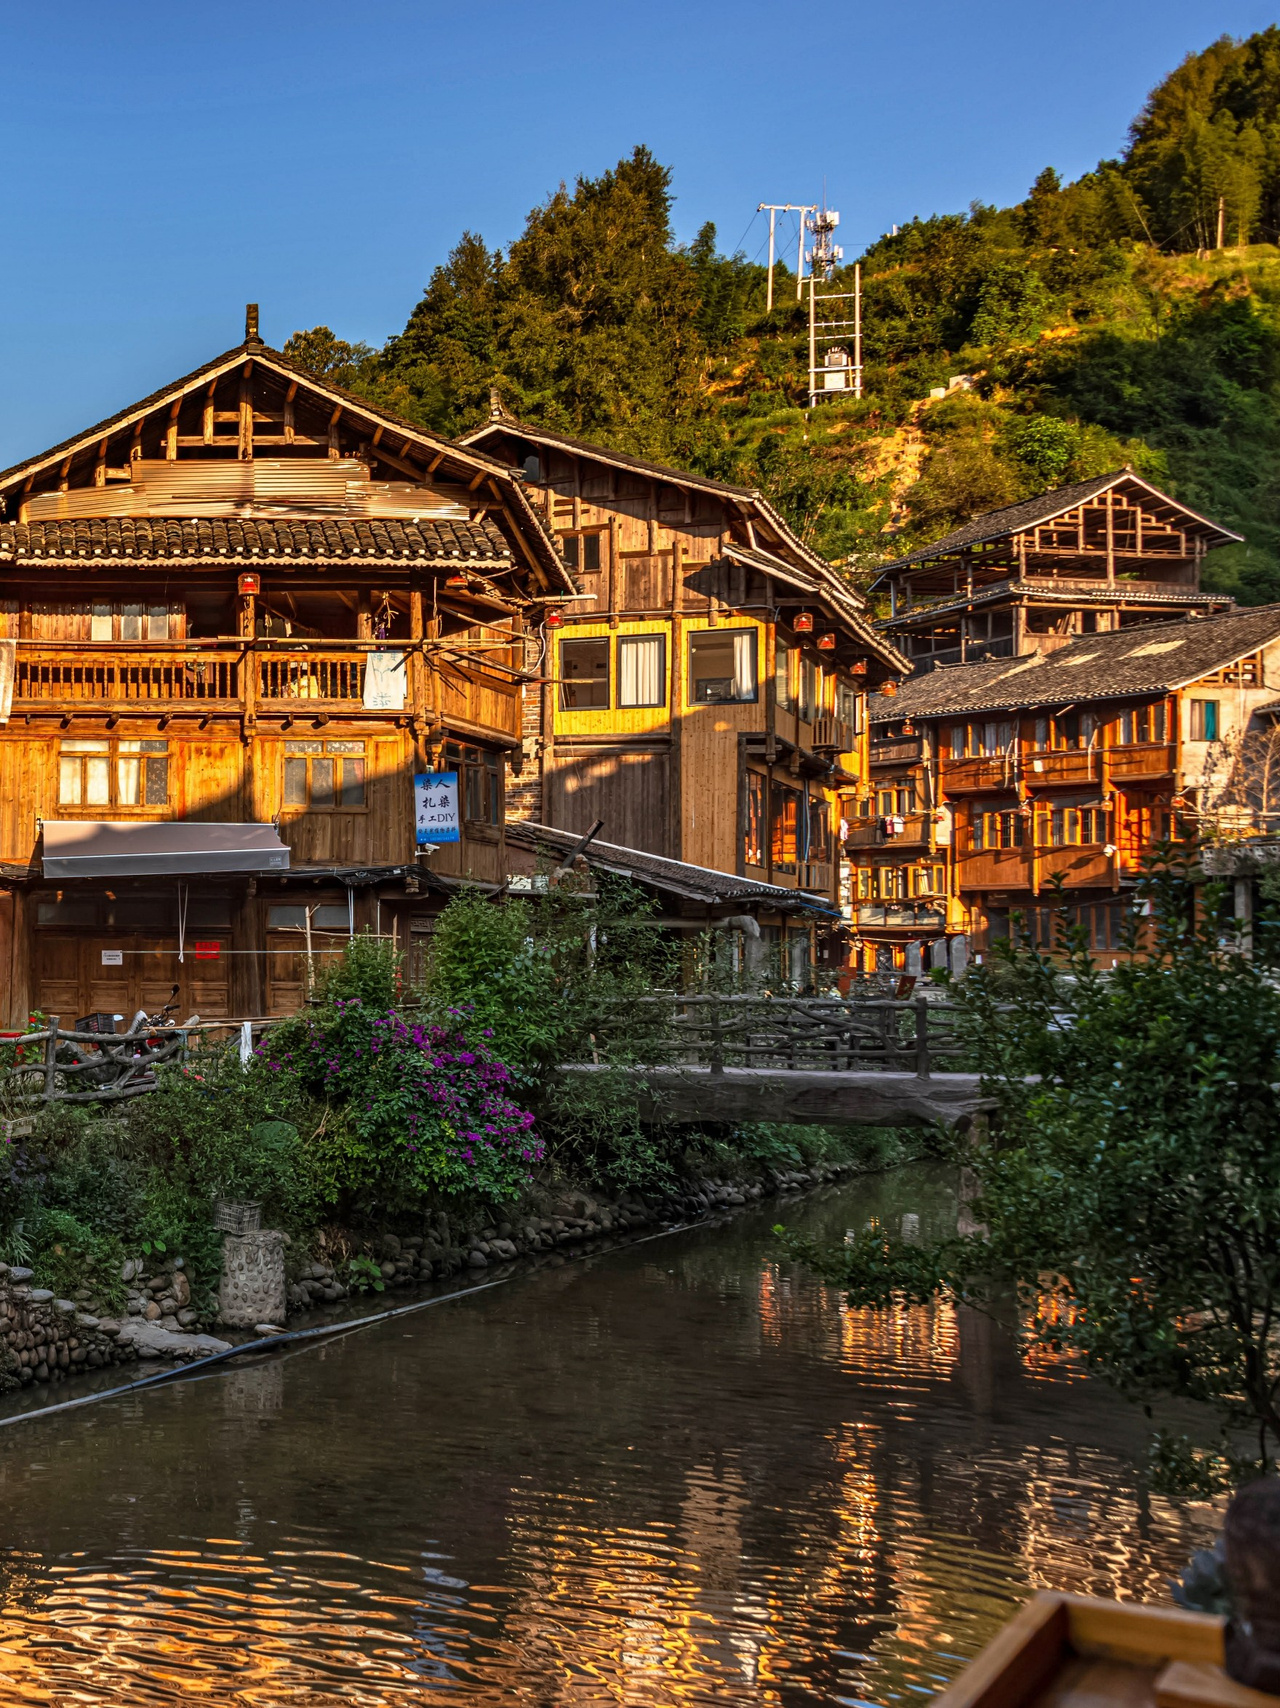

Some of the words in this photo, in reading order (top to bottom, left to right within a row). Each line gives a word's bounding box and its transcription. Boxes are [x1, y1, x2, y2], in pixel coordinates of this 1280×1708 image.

[420, 778, 450, 791] 染人
[422, 795, 451, 809] 扎染
[418, 813, 456, 824] 手工DIY
